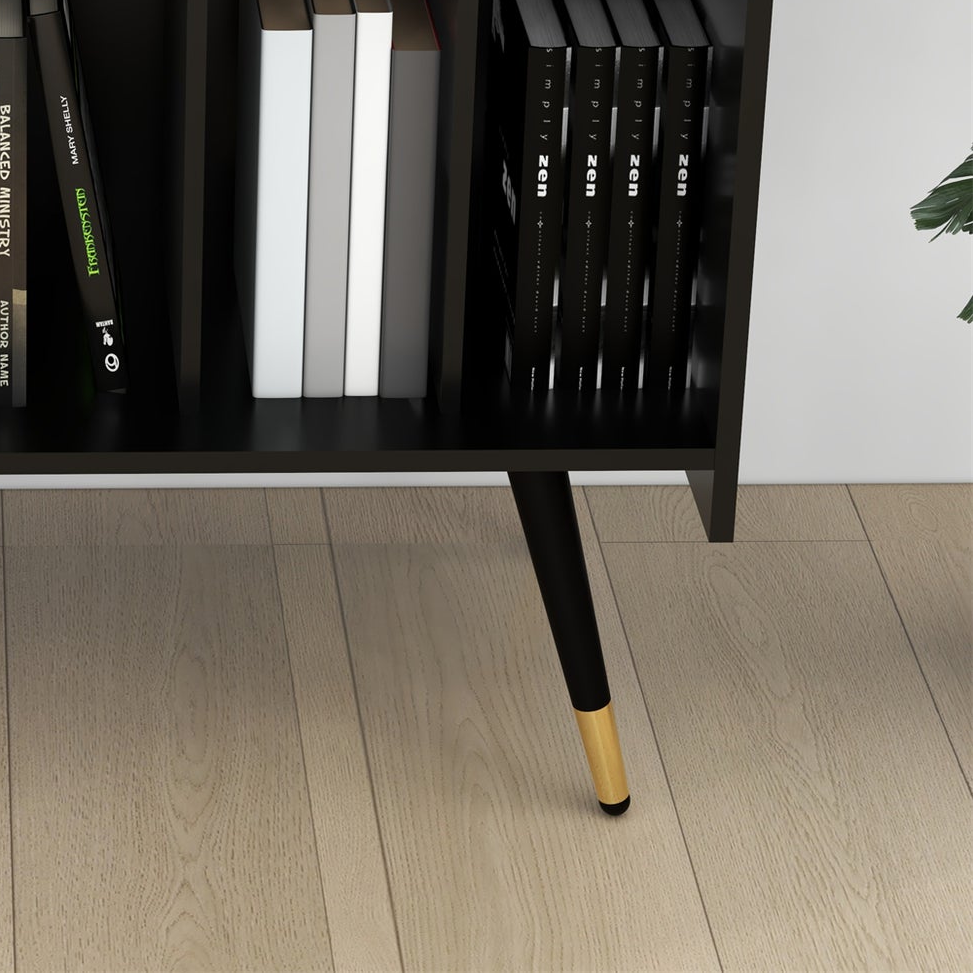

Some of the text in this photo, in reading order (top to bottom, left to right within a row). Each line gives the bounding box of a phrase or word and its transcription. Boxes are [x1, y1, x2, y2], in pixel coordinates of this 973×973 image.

[59, 95, 79, 165] MARY SHELLY
[0, 104, 11, 257] BALANCED MINISTRY
[537, 155, 549, 197] zen
[585, 155, 597, 197] zen
[628, 155, 640, 197] zen
[677, 155, 689, 197] zen
[0, 299, 9, 387] AUTHOR NAME
